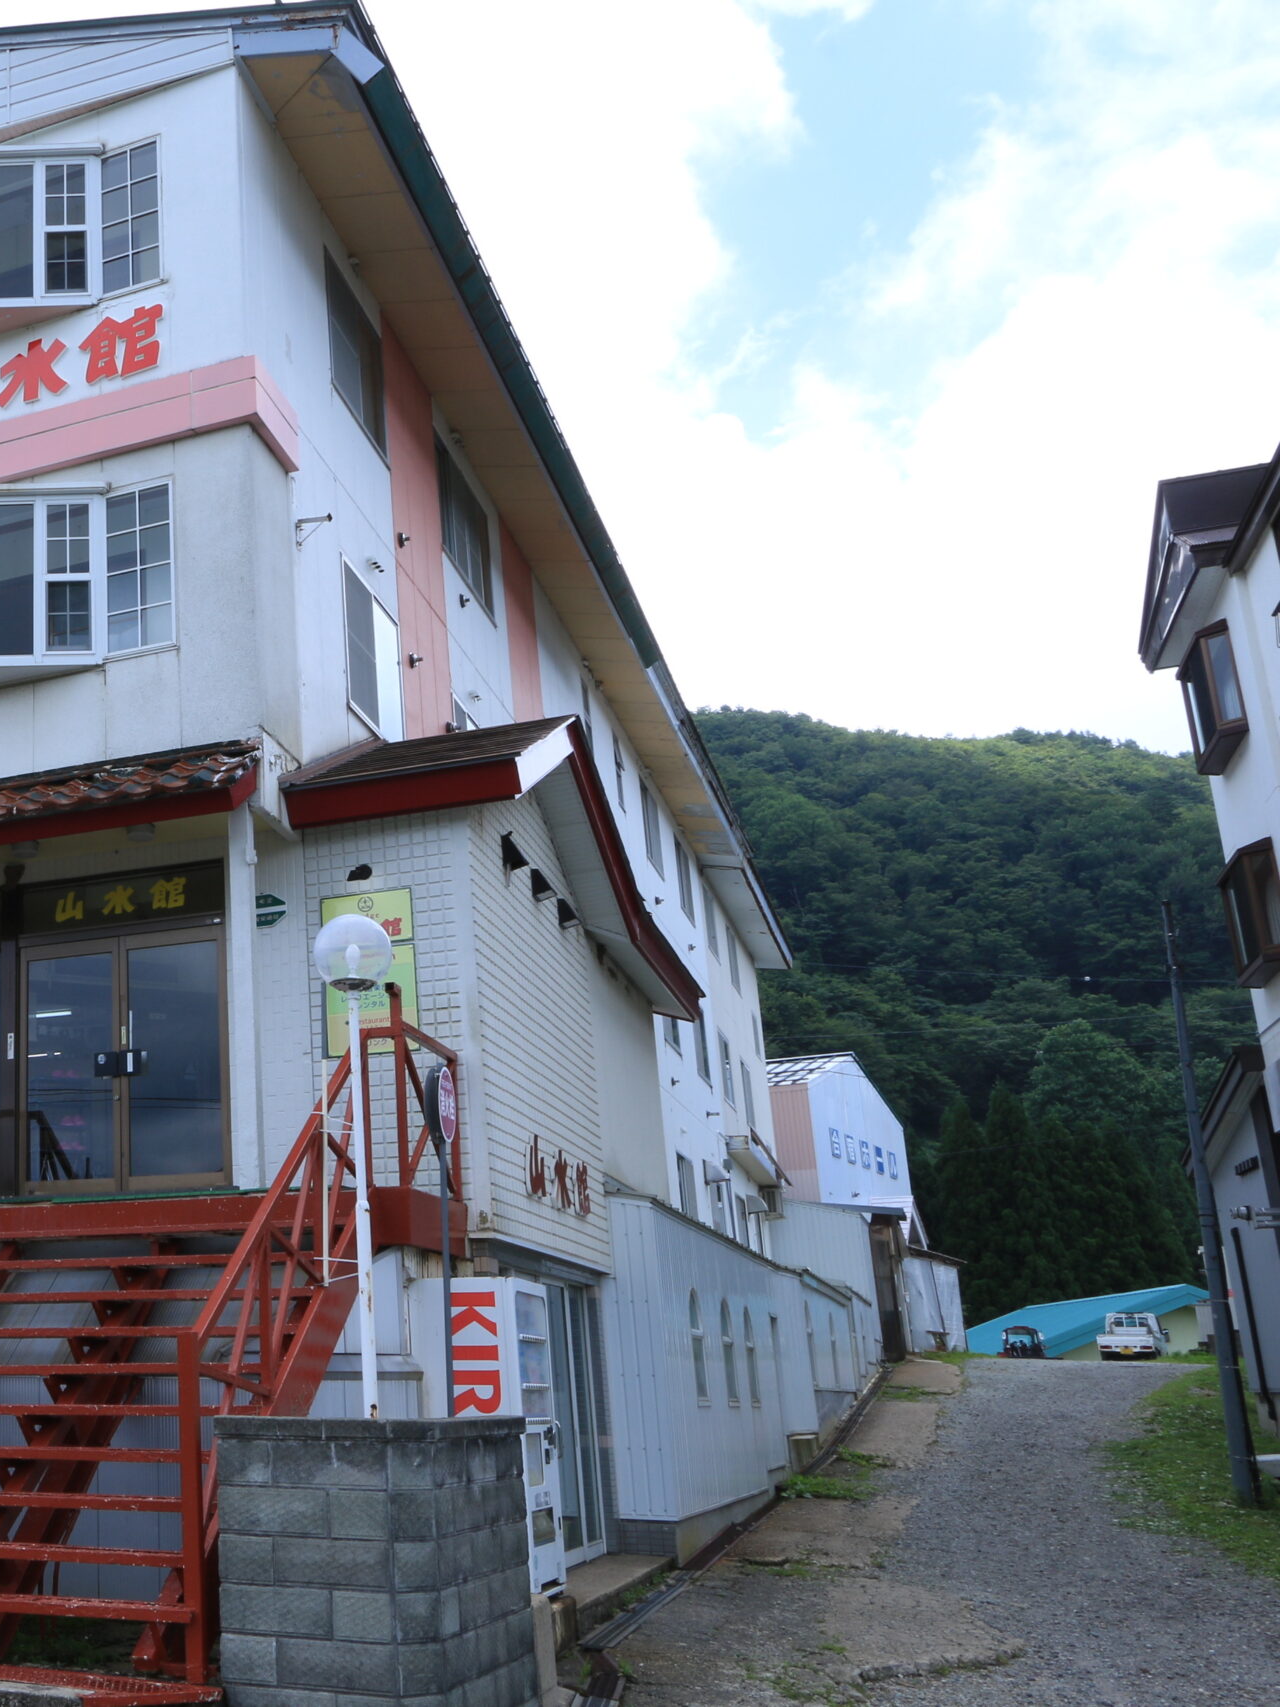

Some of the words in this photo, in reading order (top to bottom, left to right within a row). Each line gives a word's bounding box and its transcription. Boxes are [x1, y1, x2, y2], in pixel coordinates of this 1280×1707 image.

[54, 877, 187, 922] 山水館
[527, 1134, 591, 1215] 山水館
